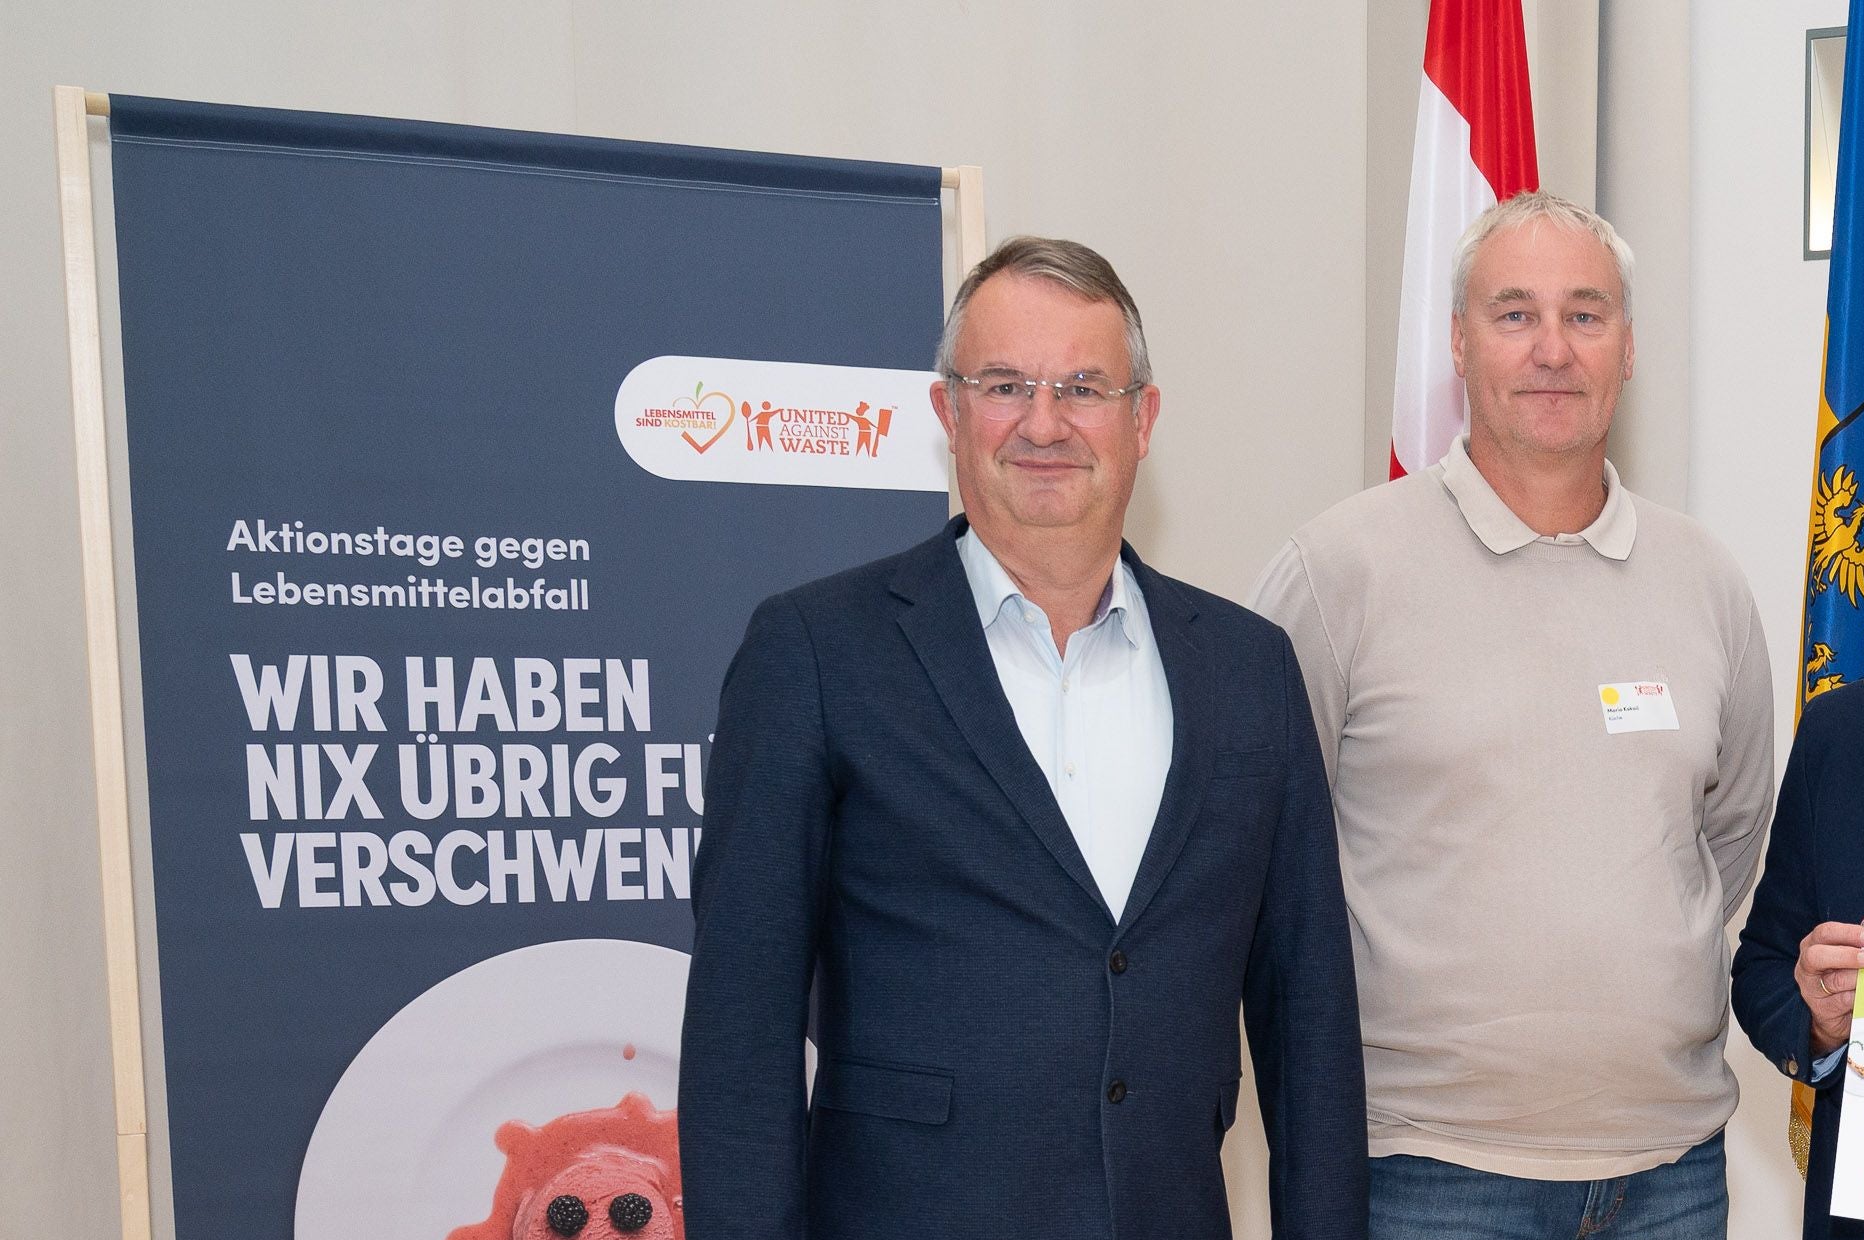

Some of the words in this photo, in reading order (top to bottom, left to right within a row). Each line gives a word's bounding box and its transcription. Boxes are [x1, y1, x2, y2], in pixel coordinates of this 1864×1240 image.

[635, 417, 663, 427] SIND
[664, 418, 717, 430] KOSTBAR!
[644, 408, 717, 421] LEBENSMITTEL
[779, 408, 850, 427] UNITED
[779, 423, 850, 438] AGAINST
[779, 437, 850, 456] WASTE
[226, 519, 464, 567] Aktionstage
[474, 535, 591, 569] gegen
[231, 571, 590, 611] Lebensmittelabfall
[229, 653, 388, 733] WIR
[404, 655, 651, 733] HABEN
[246, 743, 383, 821] NIX
[398, 734, 628, 820] ÜBRIG
